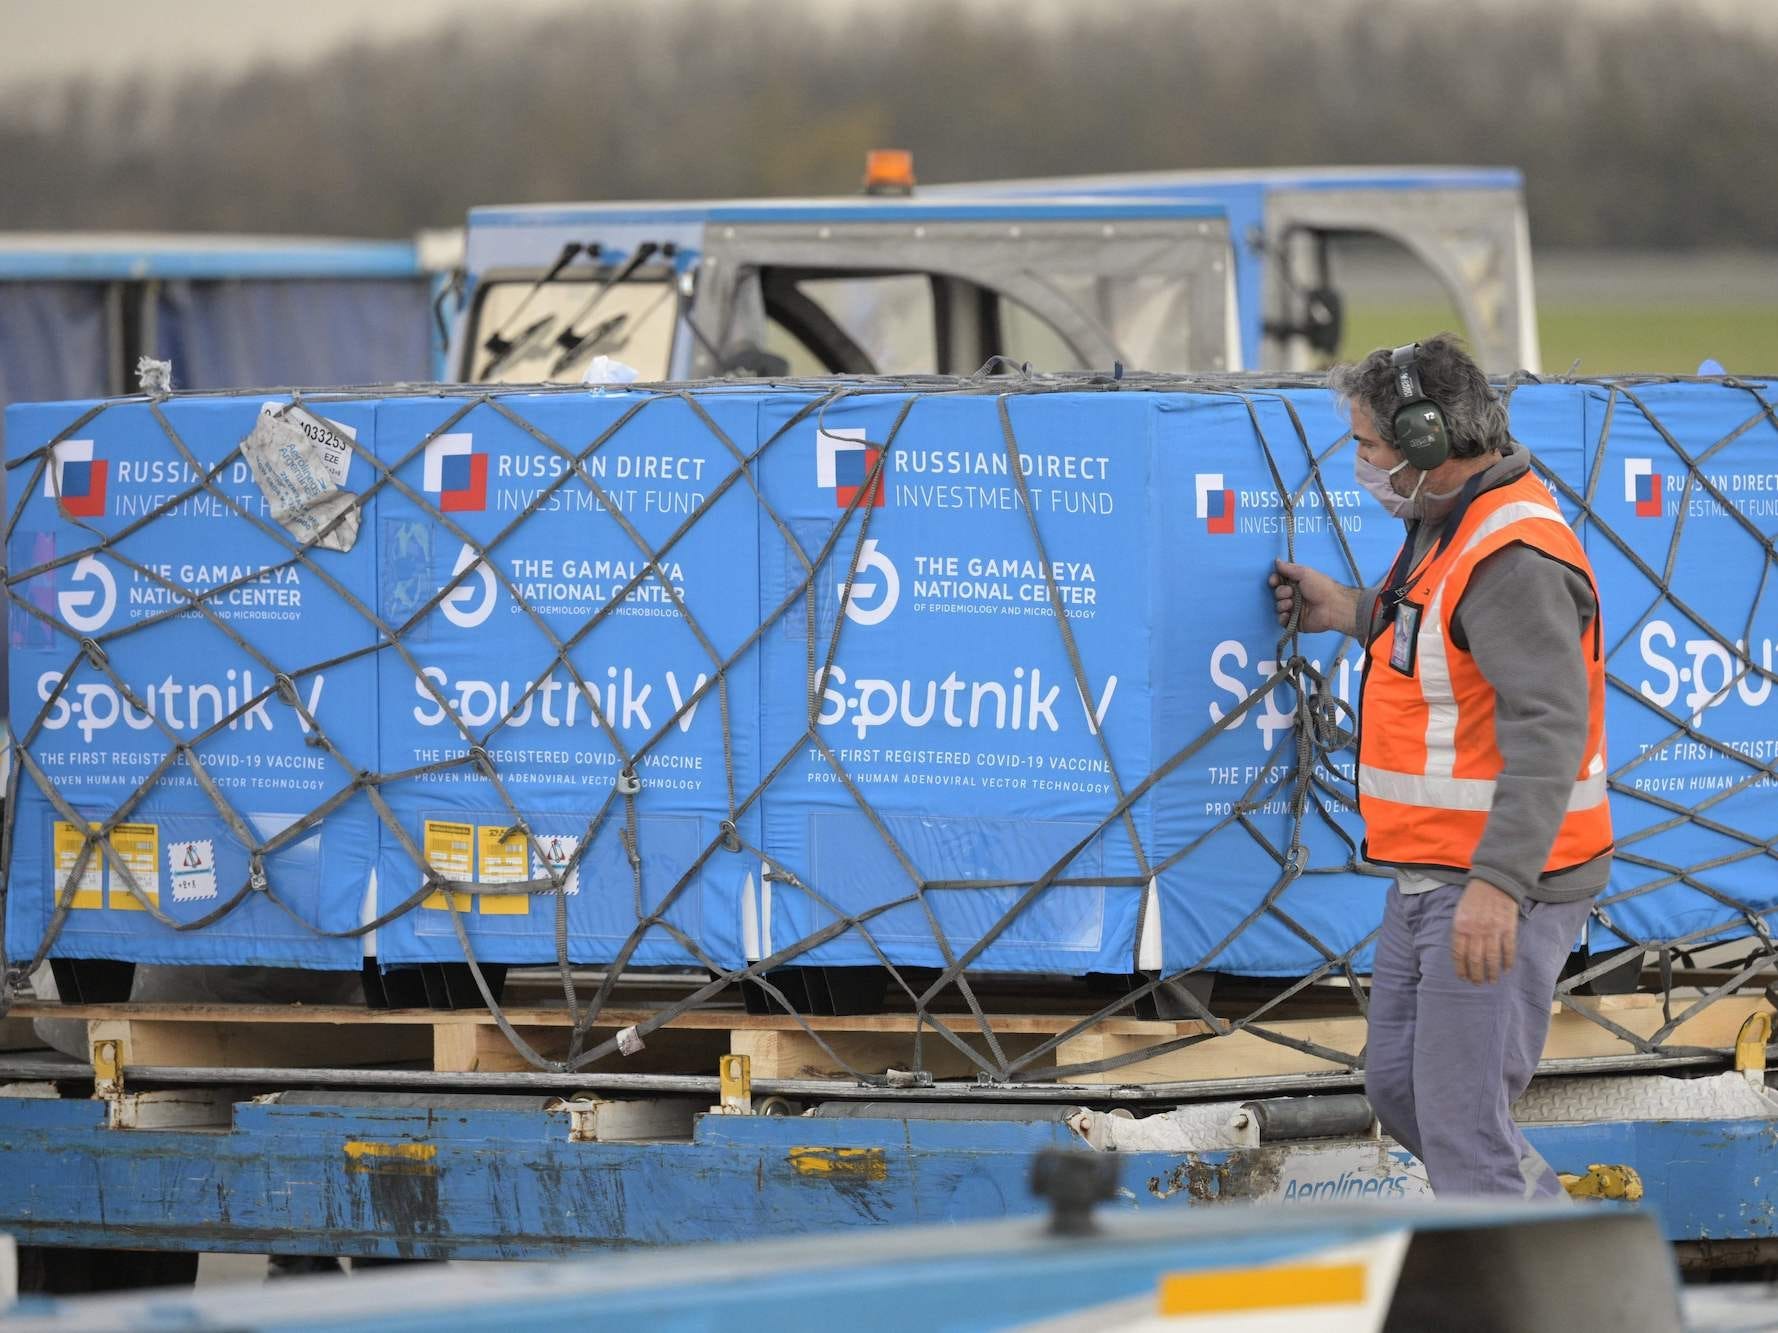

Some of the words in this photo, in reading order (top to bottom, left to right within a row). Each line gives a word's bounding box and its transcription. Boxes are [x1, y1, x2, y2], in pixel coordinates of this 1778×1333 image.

[324, 452, 340, 465] EZE
[617, 456, 705, 480] DIRECT
[895, 450, 1008, 475] RUSSIAN
[1018, 454, 1109, 480] DIRECT
[1667, 475, 1728, 492] RUSAN
[645, 491, 705, 513] FUND
[896, 485, 1043, 511] INVESTMENT
[1052, 490, 1113, 515] FUND
[1667, 500, 1745, 517] INESTMENT
[181, 564, 300, 585] GAMALEYA
[511, 560, 553, 578] THE
[914, 556, 959, 576] THE
[967, 558, 1096, 582] GAMALEYA
[229, 589, 301, 606] CENTER
[511, 583, 605, 600] NATIONAL
[612, 585, 685, 603] CENTER
[914, 581, 1013, 600] NATIONAL
[130, 609, 142, 618] OF
[233, 611, 301, 621] MICROBIOLOGY
[531, 606, 591, 616] PIDEMIOLOGY
[616, 607, 686, 618] MICROBIOLOG
[914, 603, 926, 612] OF
[929, 603, 998, 614] EPIDEMIOLOGY
[1001, 606, 1021, 615] AND
[1024, 607, 1096, 619] MICROOLOGY
[1640, 620, 1778, 728] Spu
[287, 674, 324, 733] V
[665, 671, 707, 732] V
[1074, 675, 1118, 735] V
[40, 752, 64, 765] THE
[70, 752, 107, 765] FIRST
[112, 752, 191, 766] REGISTEED
[199, 754, 261, 768] COVID-19
[266, 755, 325, 770] VACCINE
[413, 750, 440, 762] THE
[487, 750, 569, 763] REGISTERED
[575, 752, 636, 766] COVID-
[643, 754, 703, 770] VACCINE
[841, 749, 880, 762] FIRST
[885, 750, 971, 765] REGISTERED
[976, 753, 1043, 768] COVID-19
[1049, 756, 1110, 773] VACCINE
[48, 776, 82, 785] ROVEN
[87, 776, 126, 785] HUMAN
[131, 776, 200, 787] ADOVIRAL
[212, 777, 246, 788] ECTOR
[252, 778, 324, 790] TECHNOLOGY
[464, 773, 503, 783] HUMN
[508, 774, 577, 786] ADENOVIRAL
[582, 775, 616, 786] VECTO
[642, 778, 702, 791] CHNOLOGY
[857, 774, 898, 784] HUMAN
[904, 774, 976, 786] ADENOVIRAL
[982, 777, 1026, 789] VECTOR
[1032, 779, 1110, 794] TECHNOLOGY
[1208, 767, 1239, 785] THE
[1635, 777, 1684, 792] PROVEN
[1690, 775, 1733, 790] HUMAN
[1263, 801, 1309, 815] HUMN
[1283, 1170, 1409, 1201] Aerolíneas
